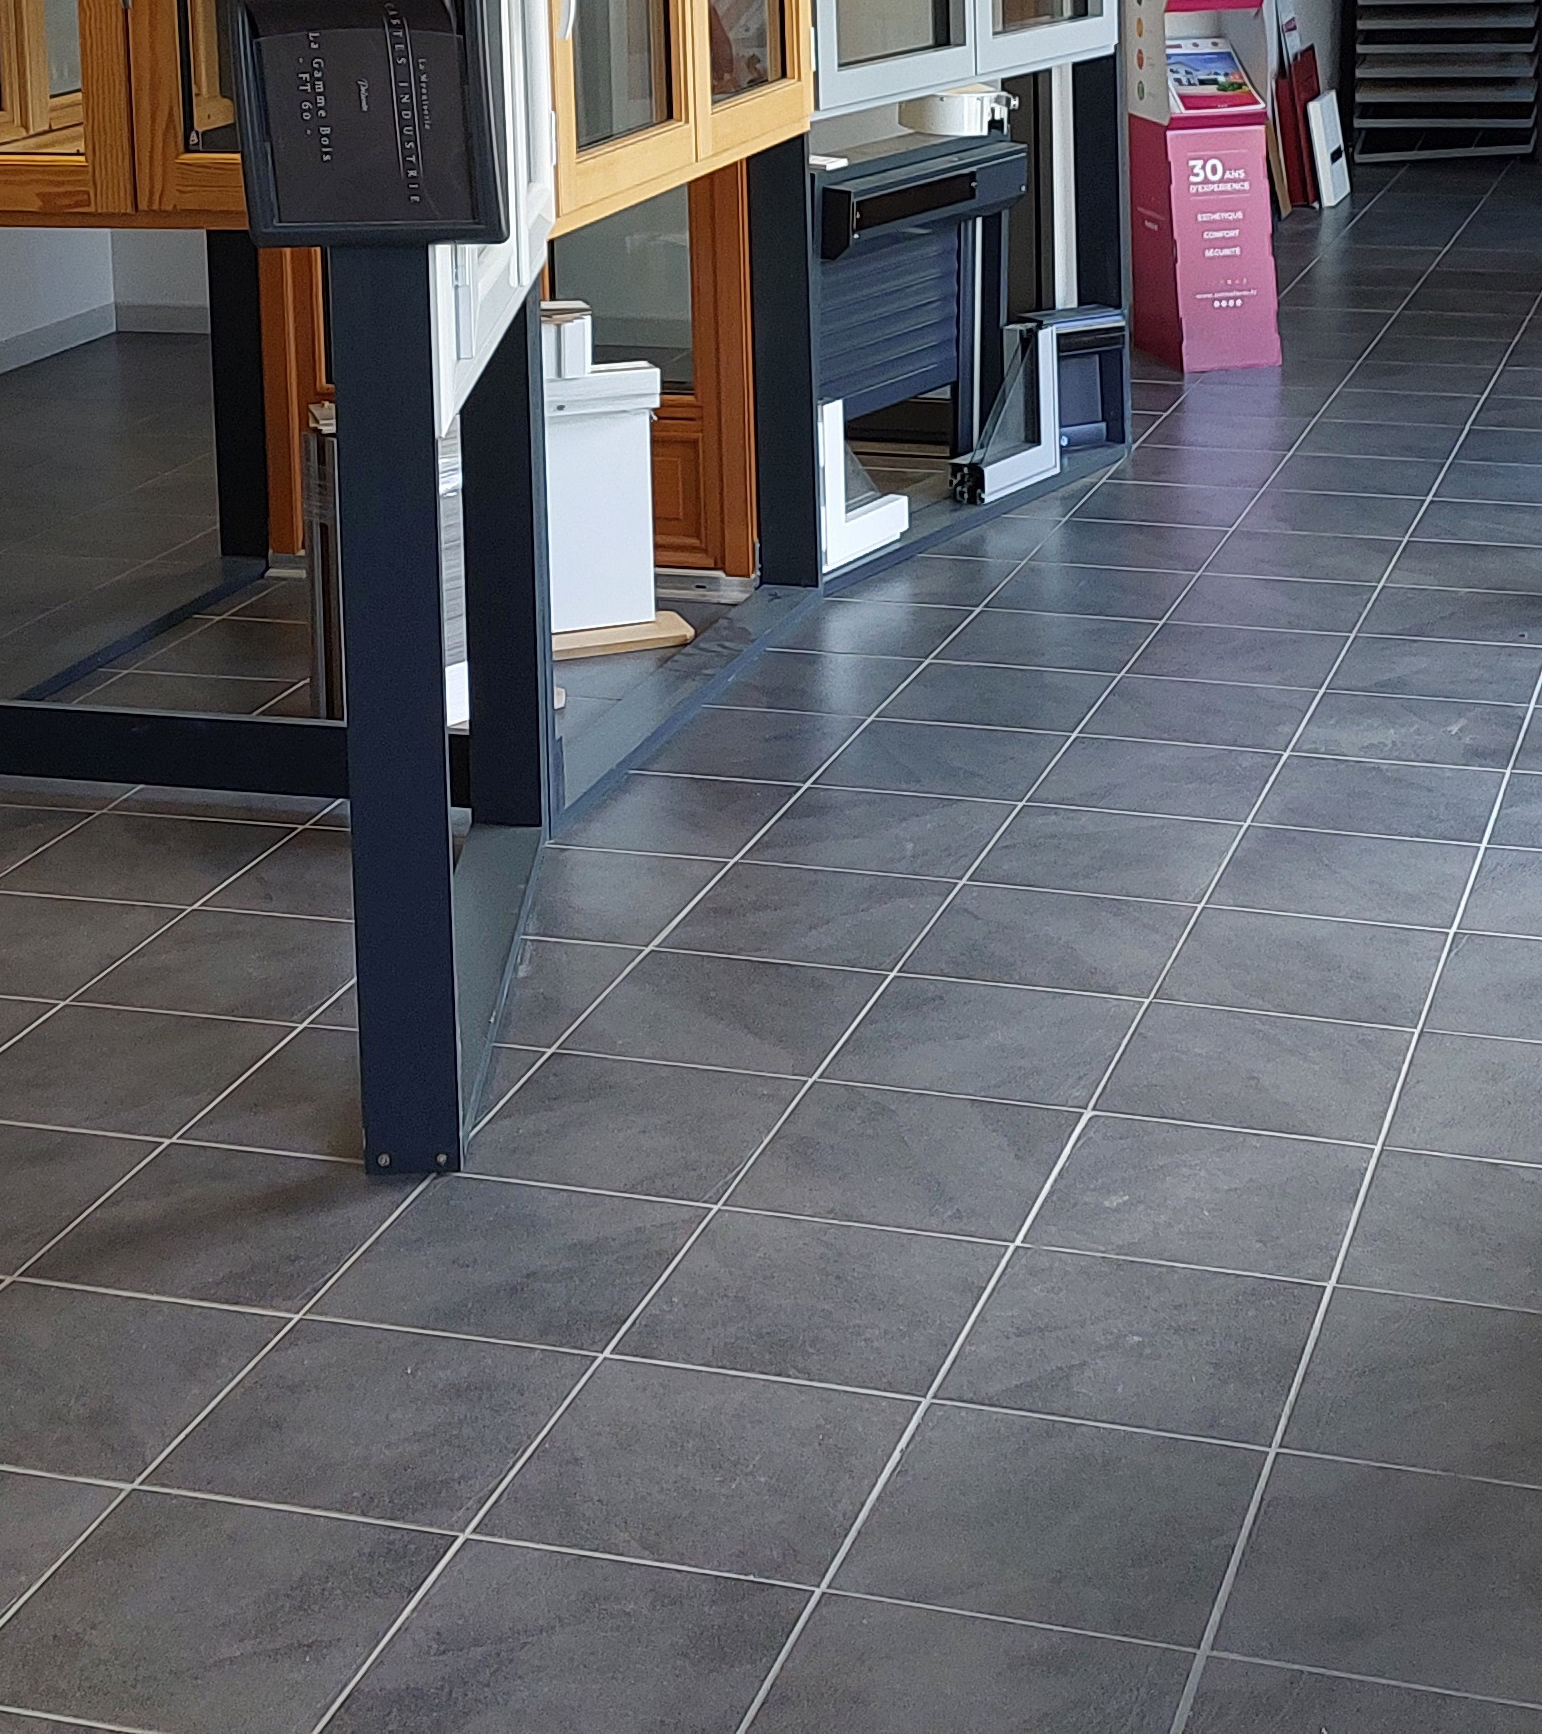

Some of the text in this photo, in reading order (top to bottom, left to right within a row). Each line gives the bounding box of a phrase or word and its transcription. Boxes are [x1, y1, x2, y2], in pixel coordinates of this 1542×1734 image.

[299, 73, 311, 94] FT
[309, 32, 333, 162] La Gamme Bois
[398, 81, 420, 204] INDUSTRIE
[1189, 158, 1245, 182] 30 ANS
[1203, 229, 1240, 239] CONFORT
